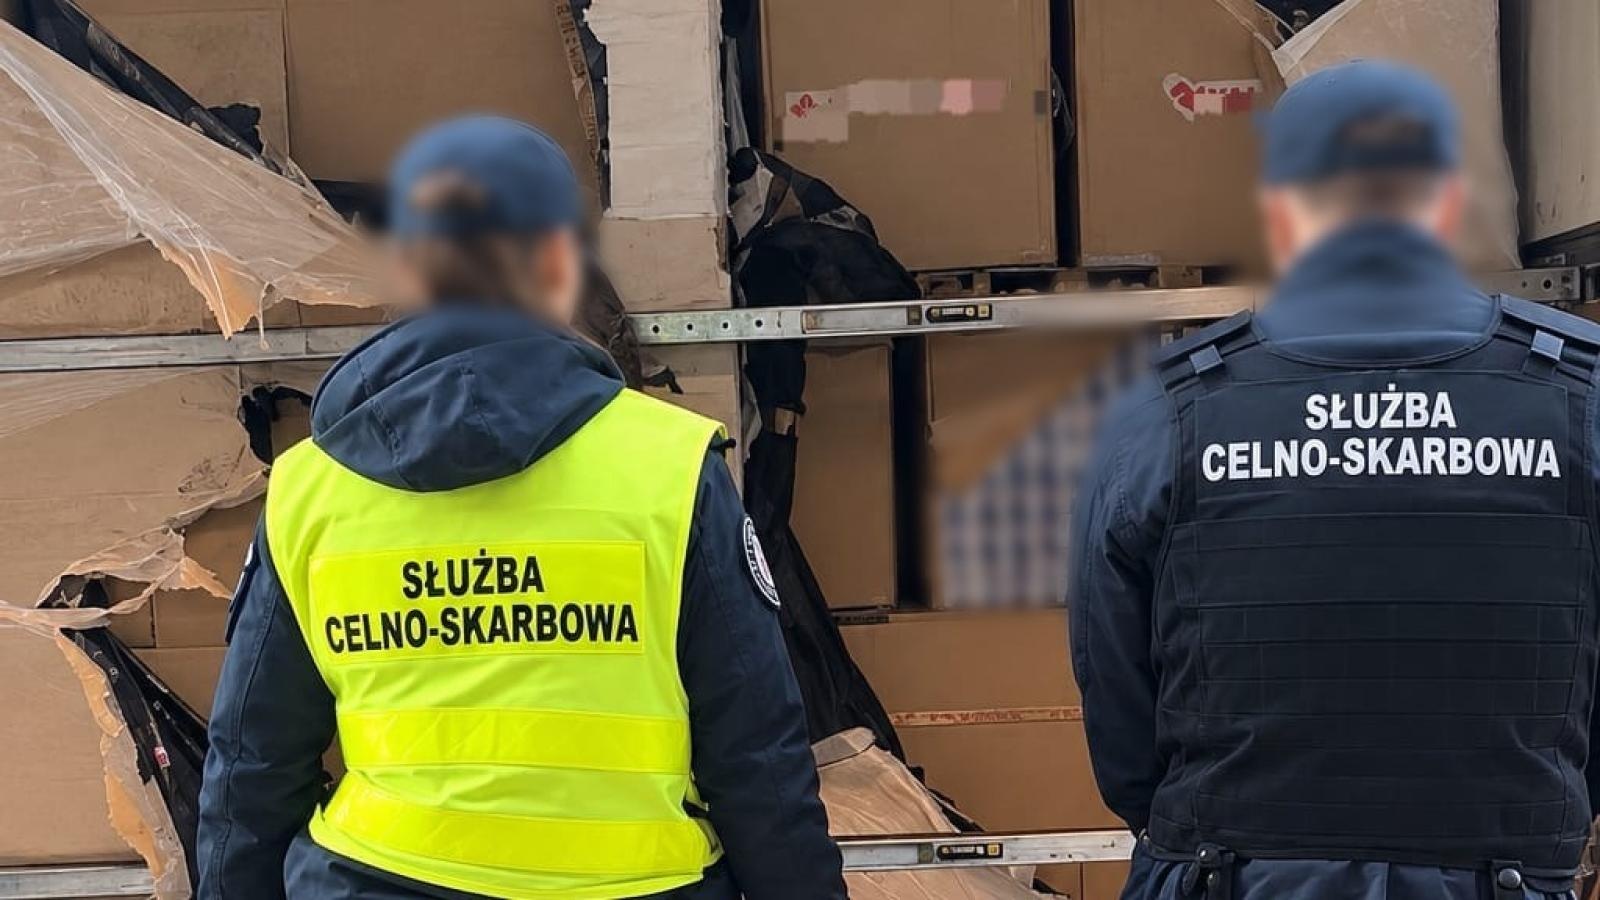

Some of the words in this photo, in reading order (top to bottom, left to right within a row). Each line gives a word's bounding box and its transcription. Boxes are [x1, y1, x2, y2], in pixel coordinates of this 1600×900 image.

[1305, 383, 1457, 430] SŁUŻBA
[1202, 437, 1561, 482] CELNO-SKARBOWA
[402, 548, 545, 599] SŁUŻBA
[325, 602, 639, 654] CELNO-SKARBOWA
